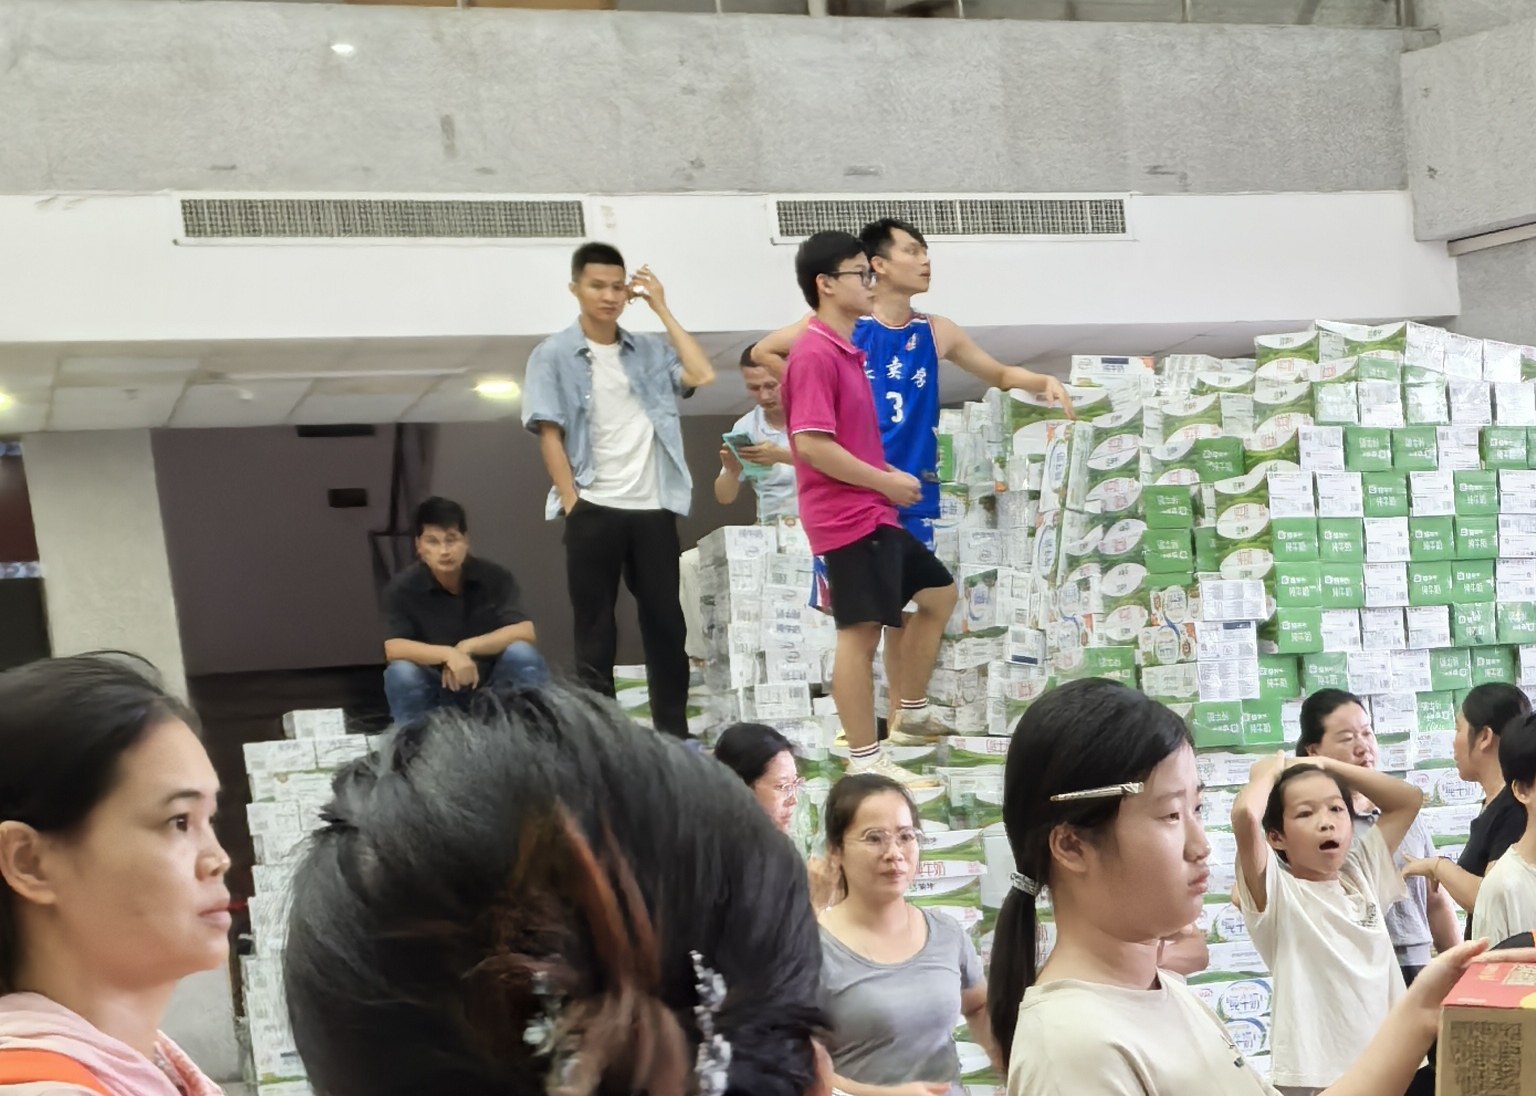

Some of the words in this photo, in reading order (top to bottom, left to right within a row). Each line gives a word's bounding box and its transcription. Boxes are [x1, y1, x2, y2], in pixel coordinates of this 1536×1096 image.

[885, 391, 903, 423] 3
[918, 861, 945, 877] 牛奶
[1229, 993, 1260, 1011] 纯牛奶
